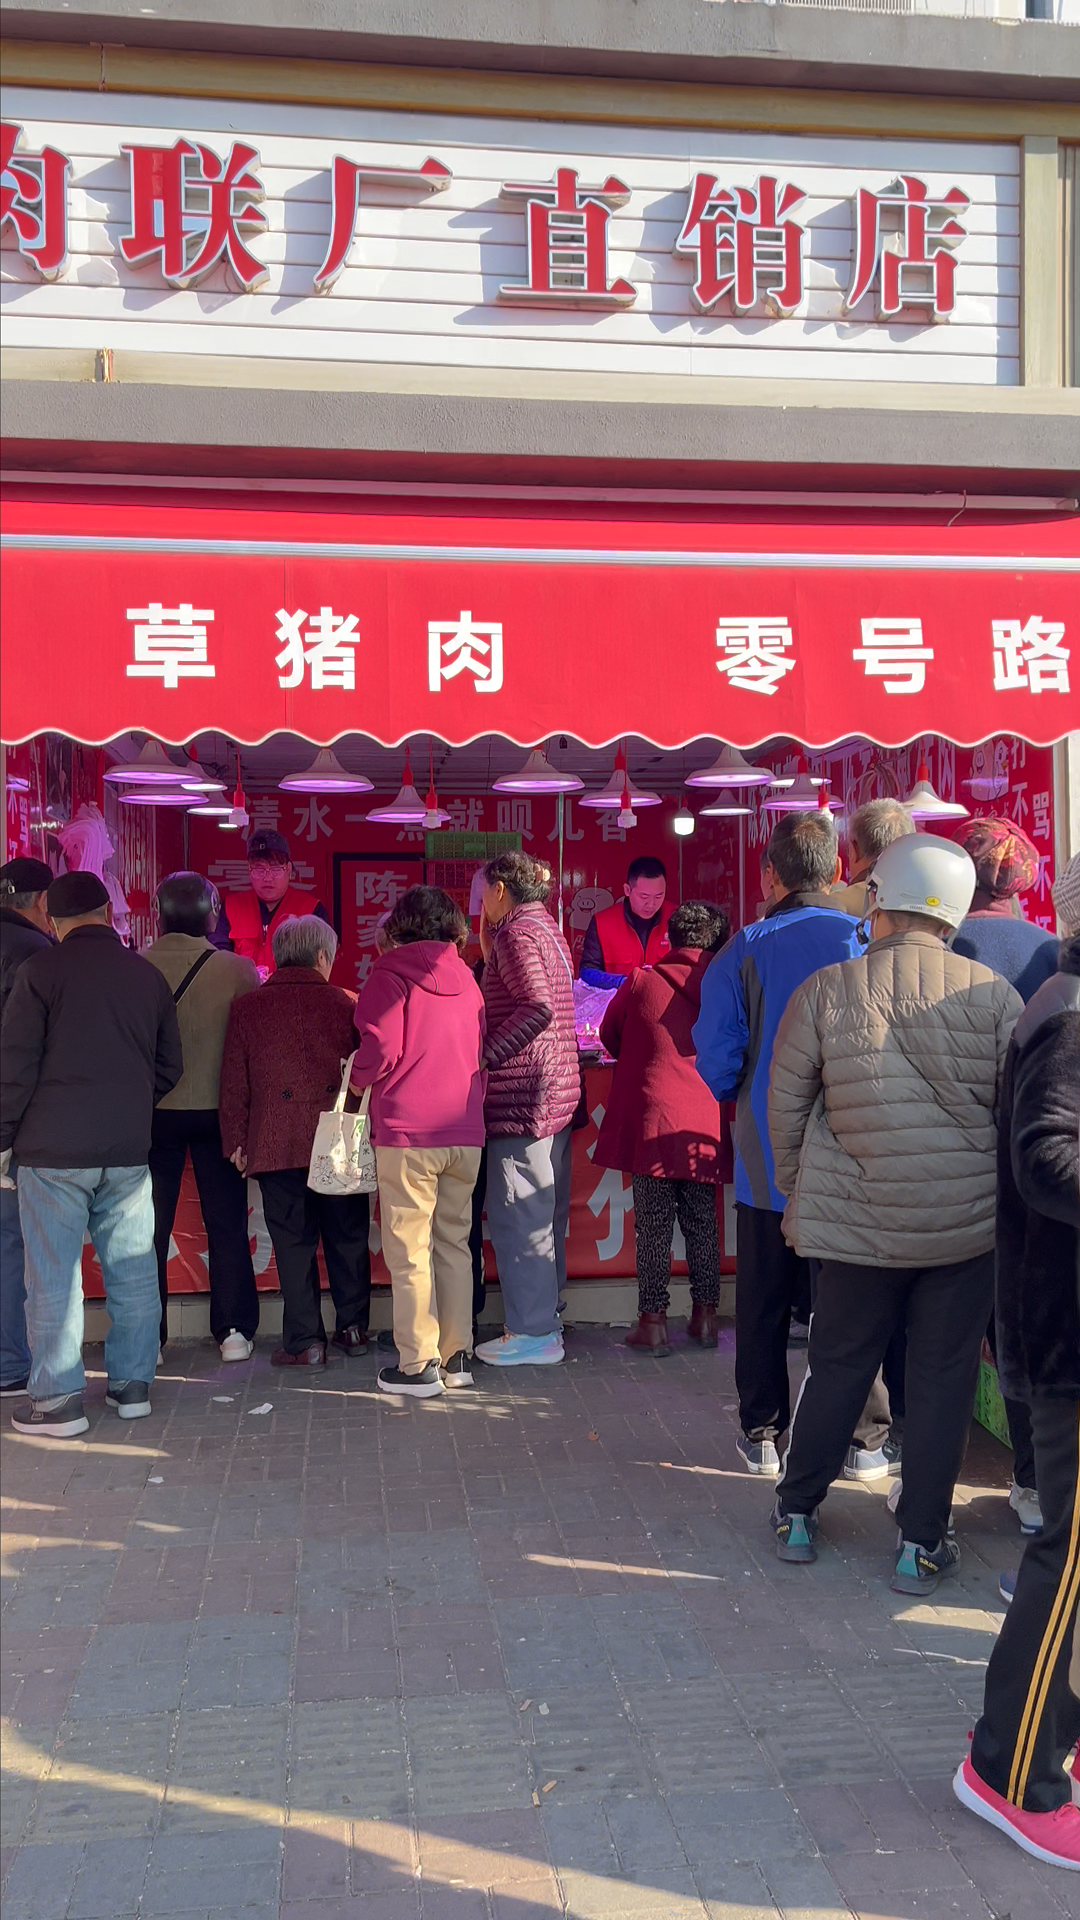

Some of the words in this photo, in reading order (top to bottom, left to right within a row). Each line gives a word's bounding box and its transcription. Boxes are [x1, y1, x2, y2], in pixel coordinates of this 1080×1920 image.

[126, 602, 503, 692] 草猪肉
[715, 615, 1071, 695] 零号路
